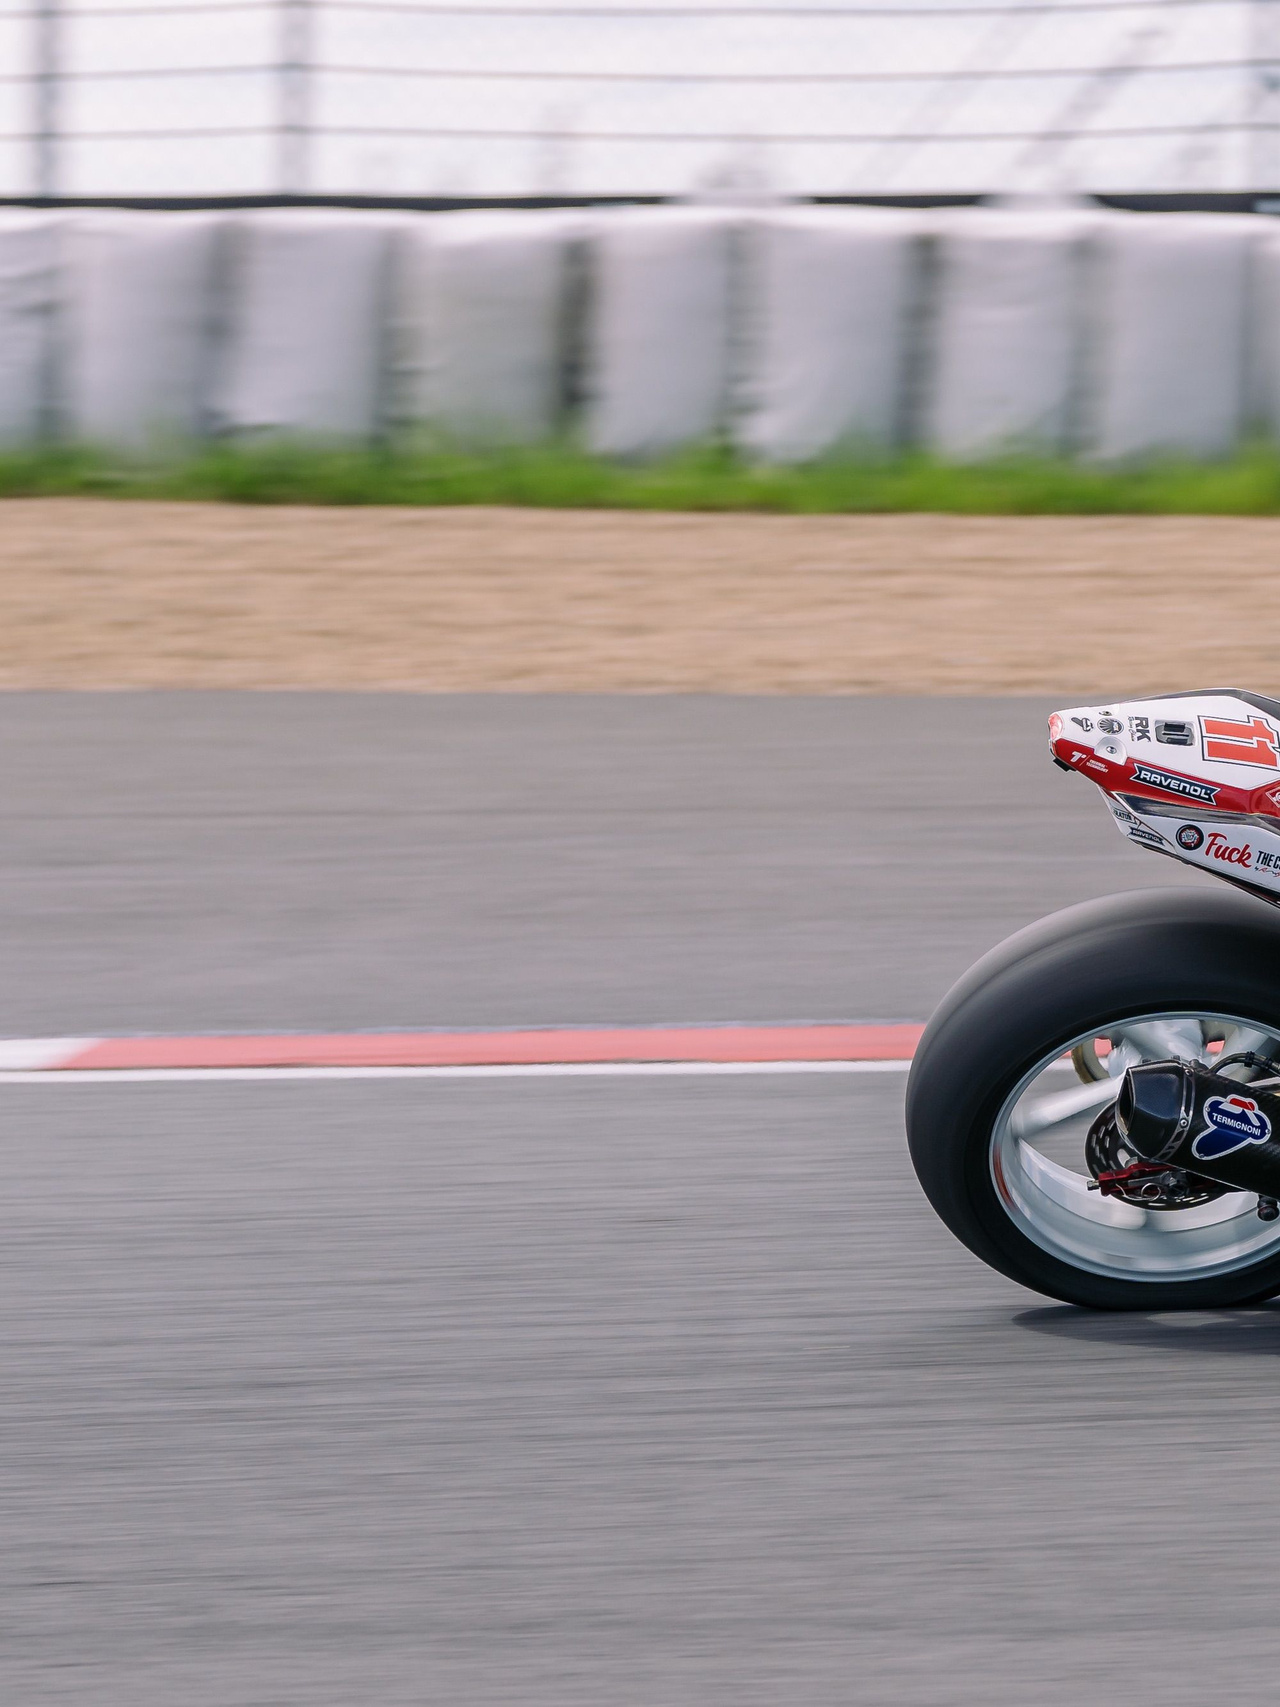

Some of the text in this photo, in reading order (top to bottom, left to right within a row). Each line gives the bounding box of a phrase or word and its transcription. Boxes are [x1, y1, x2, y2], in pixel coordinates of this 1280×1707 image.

[1135, 716, 1152, 742] RK
[1140, 769, 1210, 798] RAVENOL
[1205, 832, 1253, 868] Fuck
[1256, 850, 1275, 867] THE
[1212, 1112, 1261, 1136] TERMIGNONI
